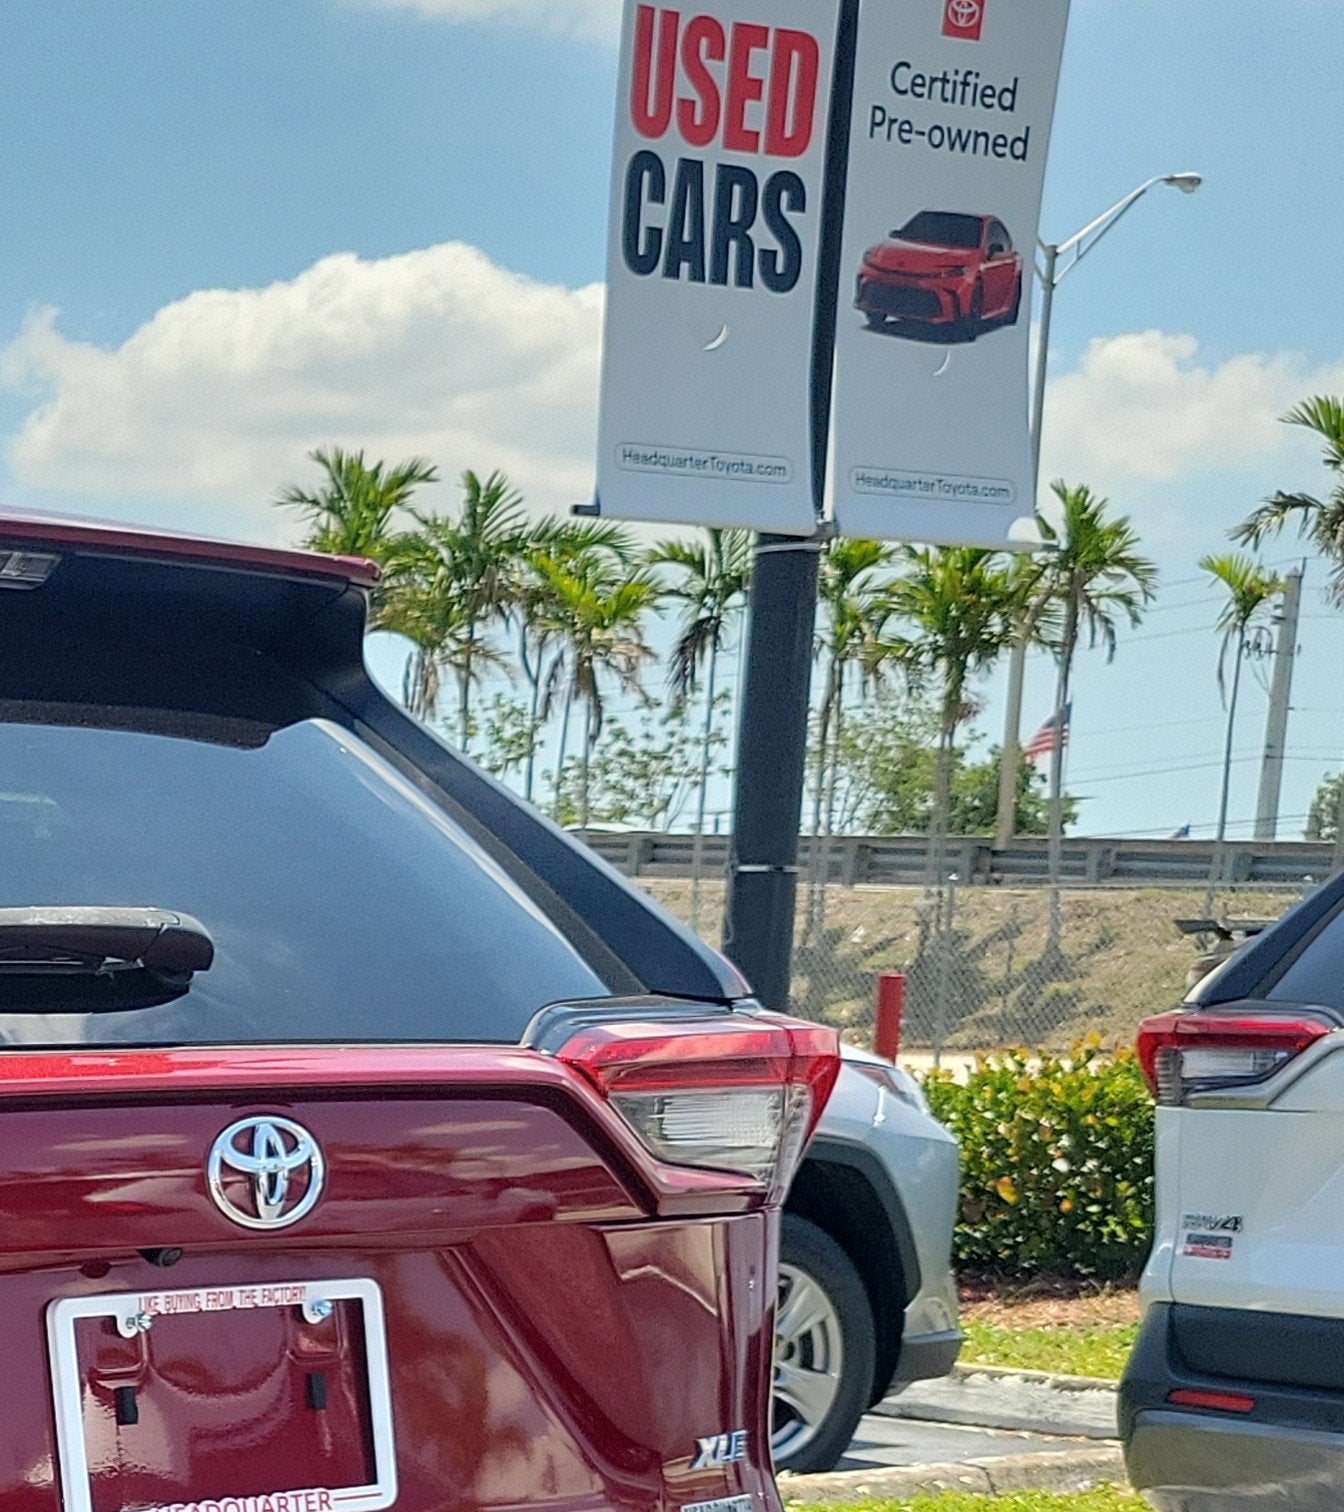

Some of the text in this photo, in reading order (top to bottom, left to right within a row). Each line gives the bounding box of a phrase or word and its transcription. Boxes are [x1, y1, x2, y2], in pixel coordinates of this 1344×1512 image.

[630, 4, 819, 158] USED
[890, 61, 1018, 112] Certified
[869, 105, 1030, 161] Pre-owned
[622, 150, 806, 293] CARS
[622, 447, 787, 478] HeadquarterToyota.com
[854, 473, 1011, 499] HeadquarterToyota.com
[206, 1290, 234, 1309] FROM
[239, 1288, 256, 1306] THE
[690, 1429, 748, 1470] XLE
